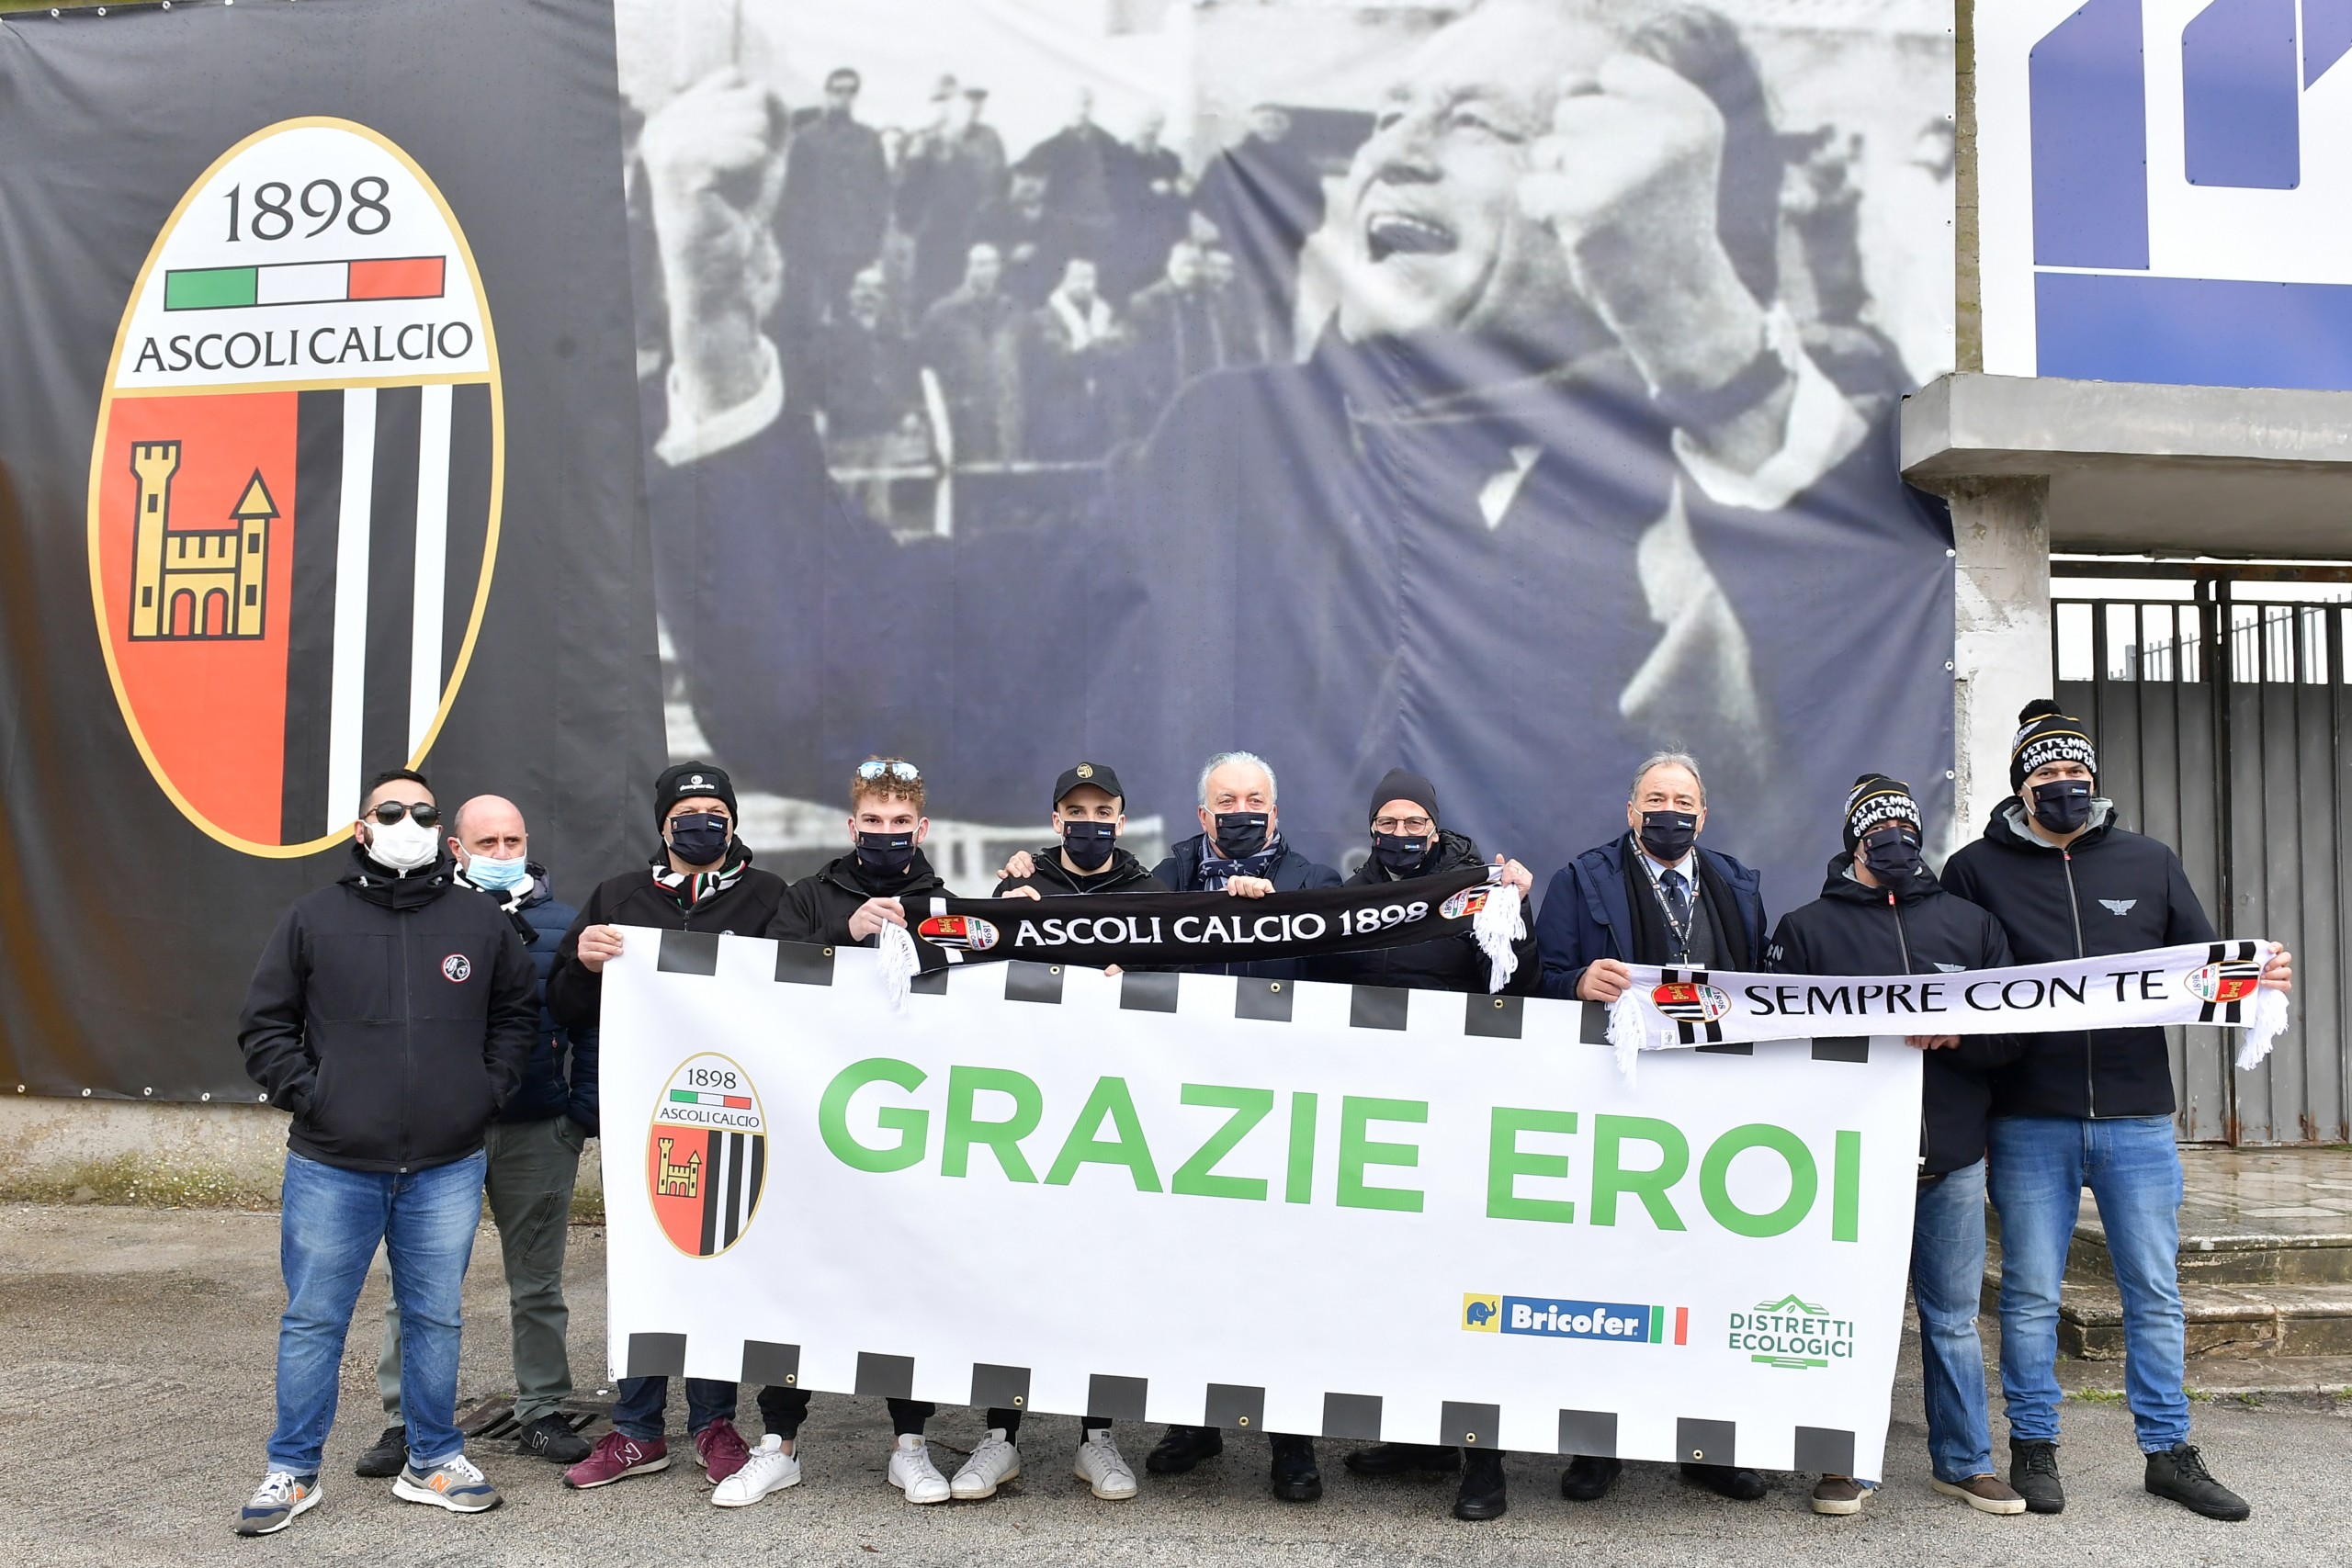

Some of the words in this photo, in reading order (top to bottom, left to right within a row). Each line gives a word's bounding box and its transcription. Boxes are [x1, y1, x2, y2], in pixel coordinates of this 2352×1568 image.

[222, 175, 391, 243] 1898
[132, 329, 300, 373] ASCOLI
[309, 321, 473, 363] CALCIO
[982, 924, 993, 944] 1898
[1014, 916, 1163, 947] ASCOLI
[1173, 912, 1326, 944] CALCIO
[1339, 900, 1430, 937] 1898
[1713, 991, 1725, 1010] 1898
[1744, 982, 1948, 1016] SEMPRE
[1965, 975, 2088, 1011] CON
[2106, 969, 2169, 1003] TE
[687, 1068, 737, 1089] 1898
[660, 1108, 710, 1122] ASCOLI
[712, 1112, 760, 1128] CALCIO
[818, 1057, 1429, 1213] GRAZIE
[1486, 1105, 1861, 1243] EROI
[1510, 1303, 1639, 1337] Bricofer
[1730, 1313, 1853, 1337] DISTRETTI
[1729, 1333, 1853, 1358] ECOLOGICI
